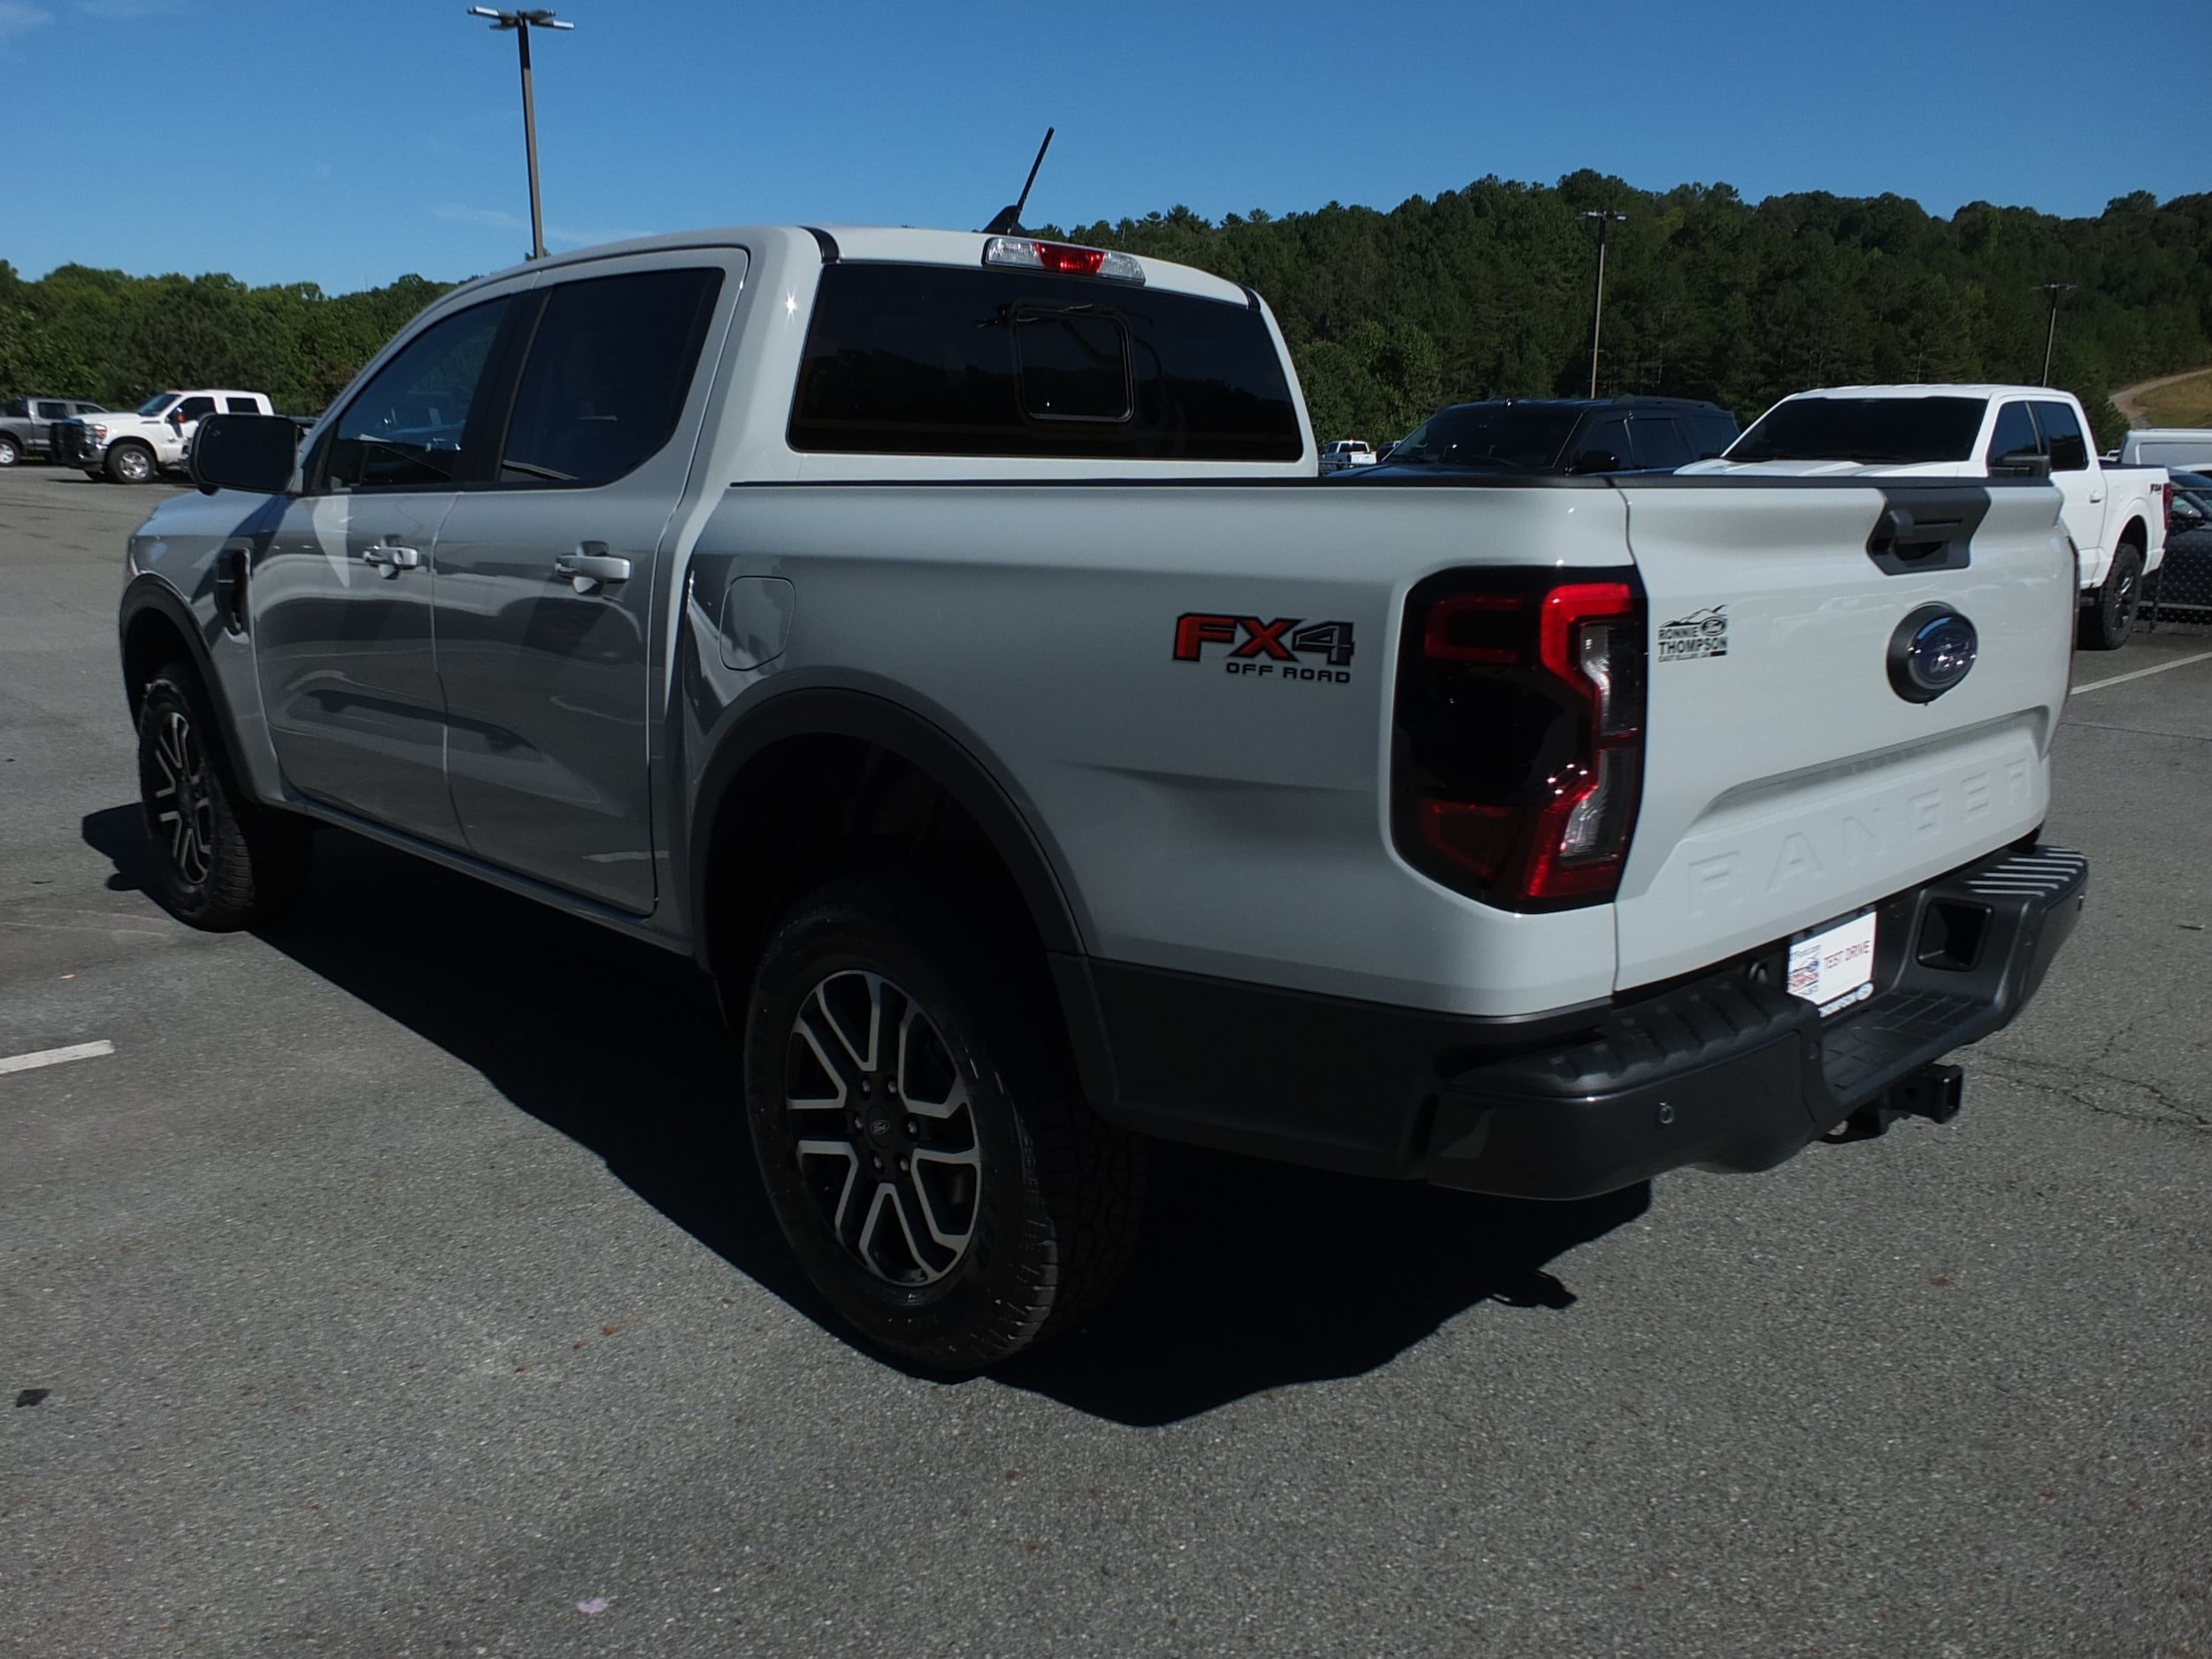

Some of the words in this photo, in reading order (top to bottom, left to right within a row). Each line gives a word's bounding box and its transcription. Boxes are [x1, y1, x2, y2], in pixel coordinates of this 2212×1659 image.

[1172, 611, 1355, 667] FX4
[1658, 626, 1699, 640] RONNIE
[1658, 637, 1727, 656] THOMPSON
[1226, 662, 1273, 676] OFF
[1283, 666, 1351, 684] ROAD
[1688, 757, 2032, 918] RANGER
[1824, 950, 1844, 970] TEST
[1845, 940, 1870, 961] DRIVE
